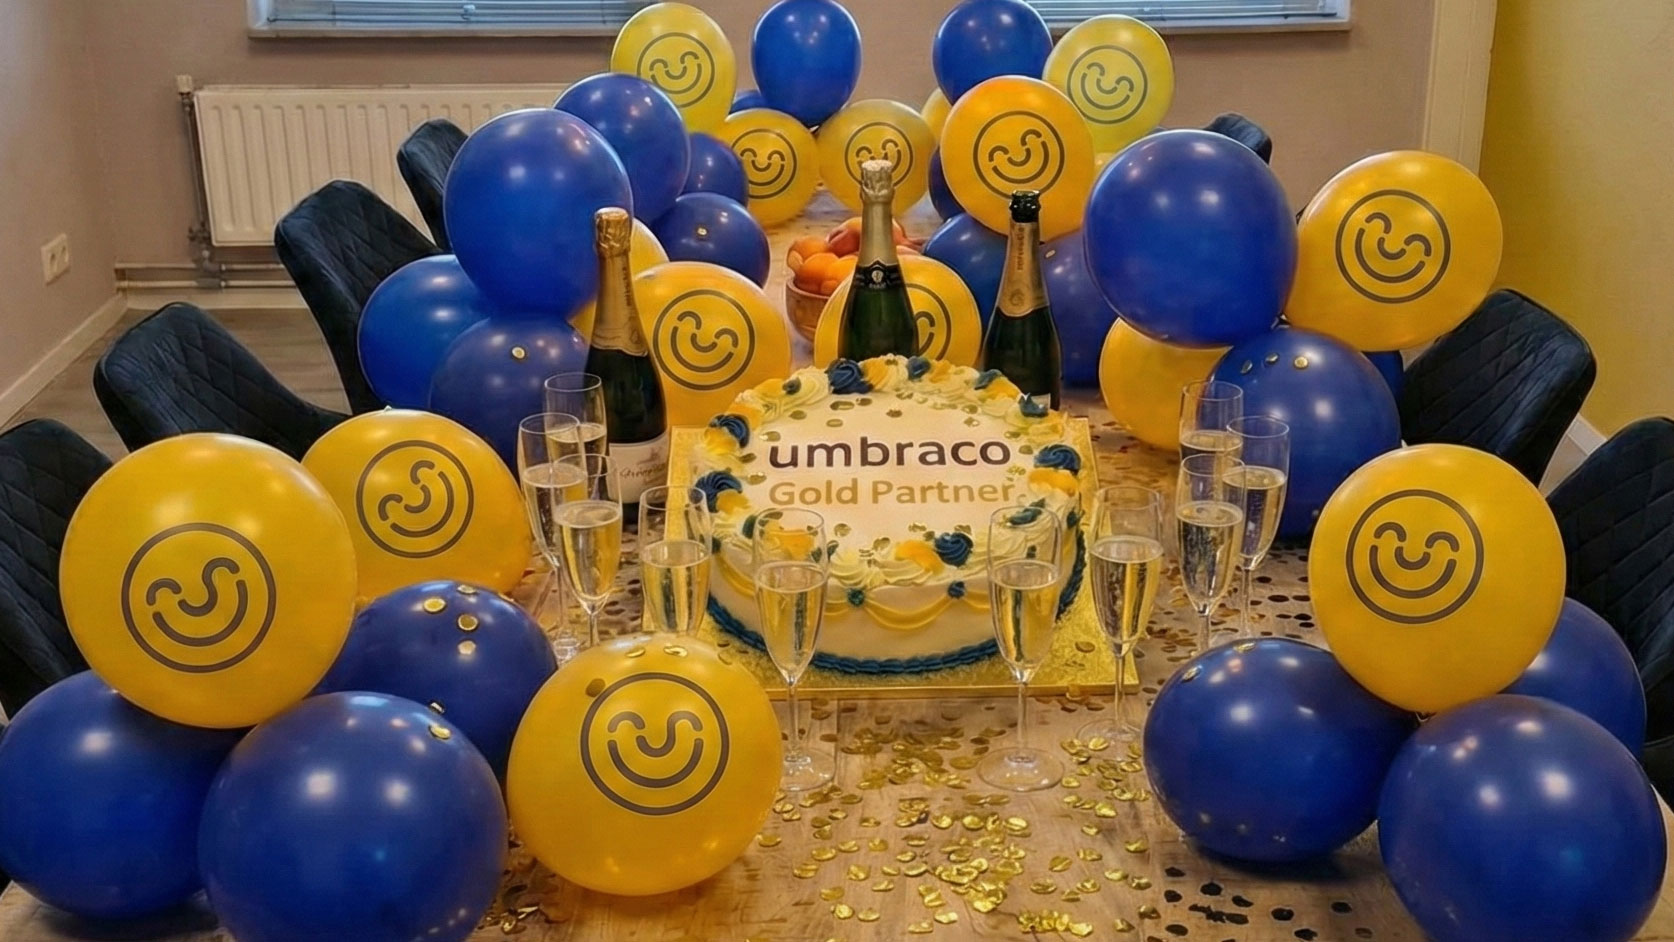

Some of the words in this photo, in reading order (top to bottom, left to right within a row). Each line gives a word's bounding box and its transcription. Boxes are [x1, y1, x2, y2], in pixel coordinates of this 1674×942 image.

[769, 436, 1011, 468] umbraco
[769, 478, 858, 506] Gold
[872, 480, 1015, 504] Partner
